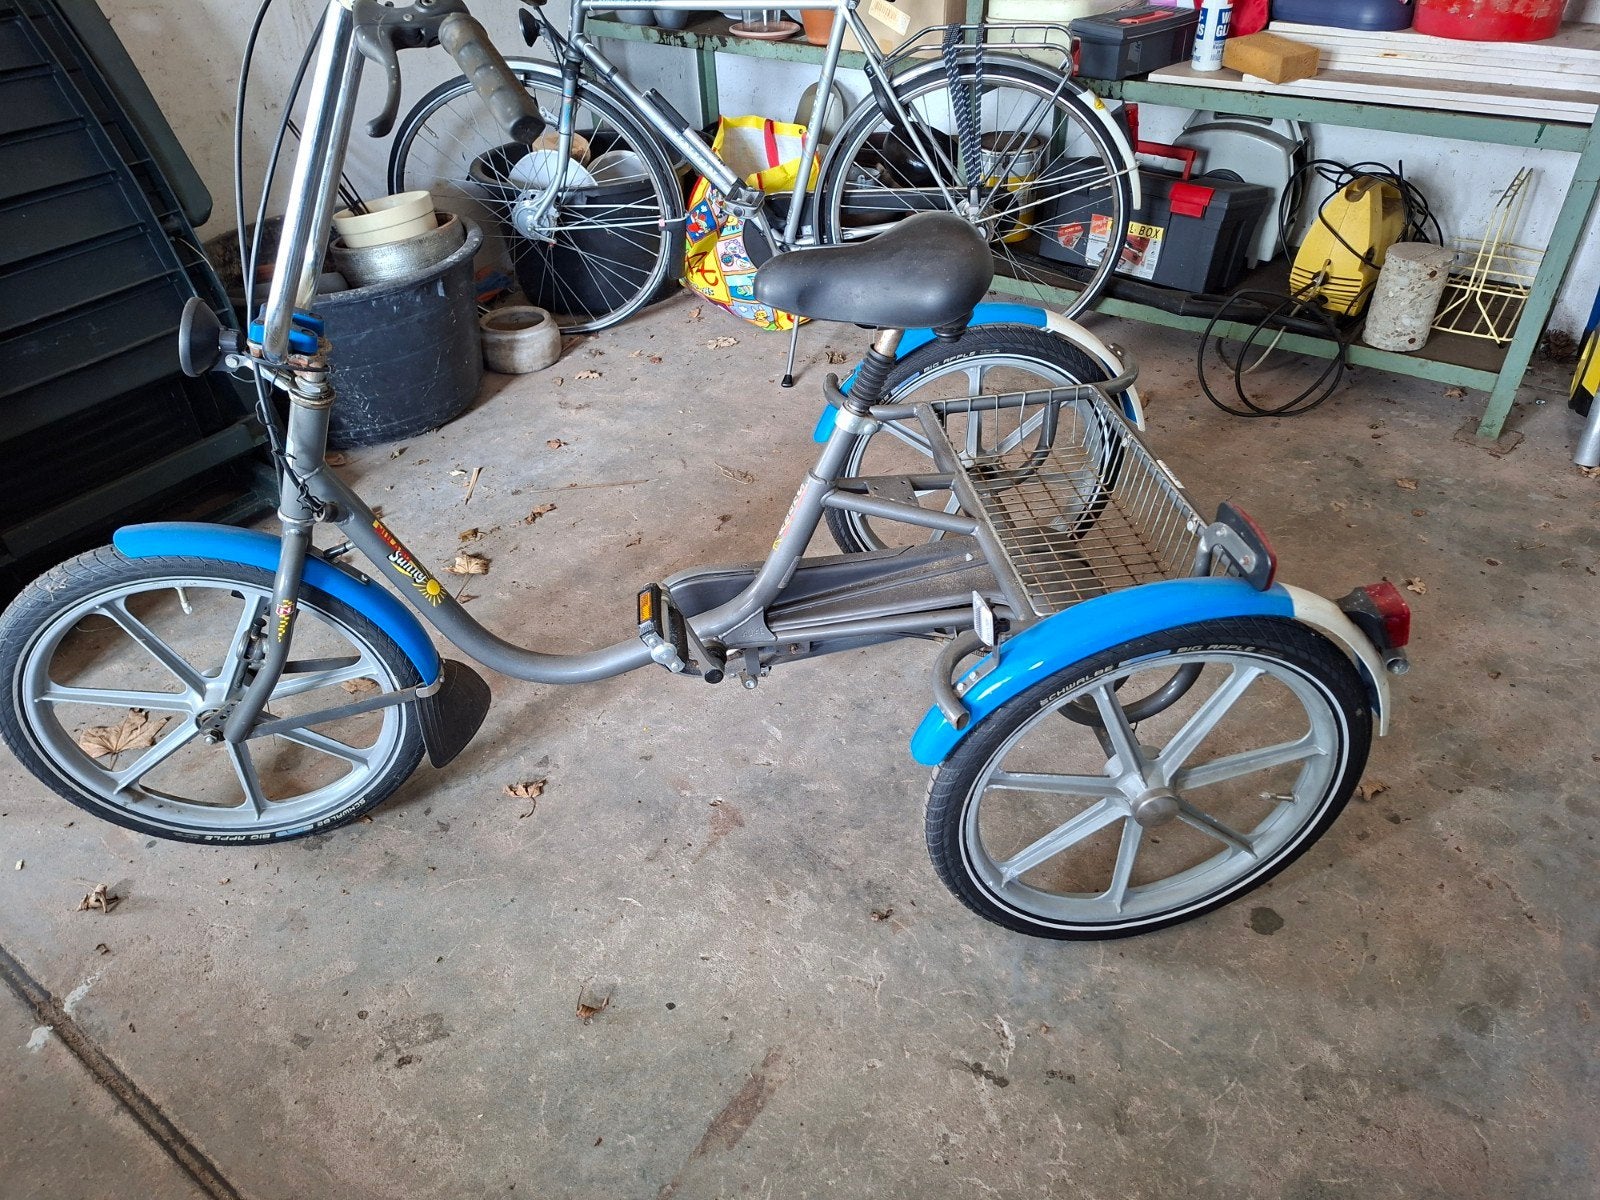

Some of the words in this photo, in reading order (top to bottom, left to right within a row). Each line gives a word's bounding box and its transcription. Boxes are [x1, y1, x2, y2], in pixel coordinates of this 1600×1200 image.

[1138, 225, 1161, 239] BOX
[923, 361, 940, 373] BIG
[943, 350, 976, 364] APPLE
[388, 550, 427, 583] Sunny
[1039, 664, 1115, 708] SCHWALBE
[1176, 645, 1204, 654] BIG
[1208, 644, 1256, 652] APPLE
[316, 797, 367, 827] SCHWALBE
[250, 833, 271, 841] BIG
